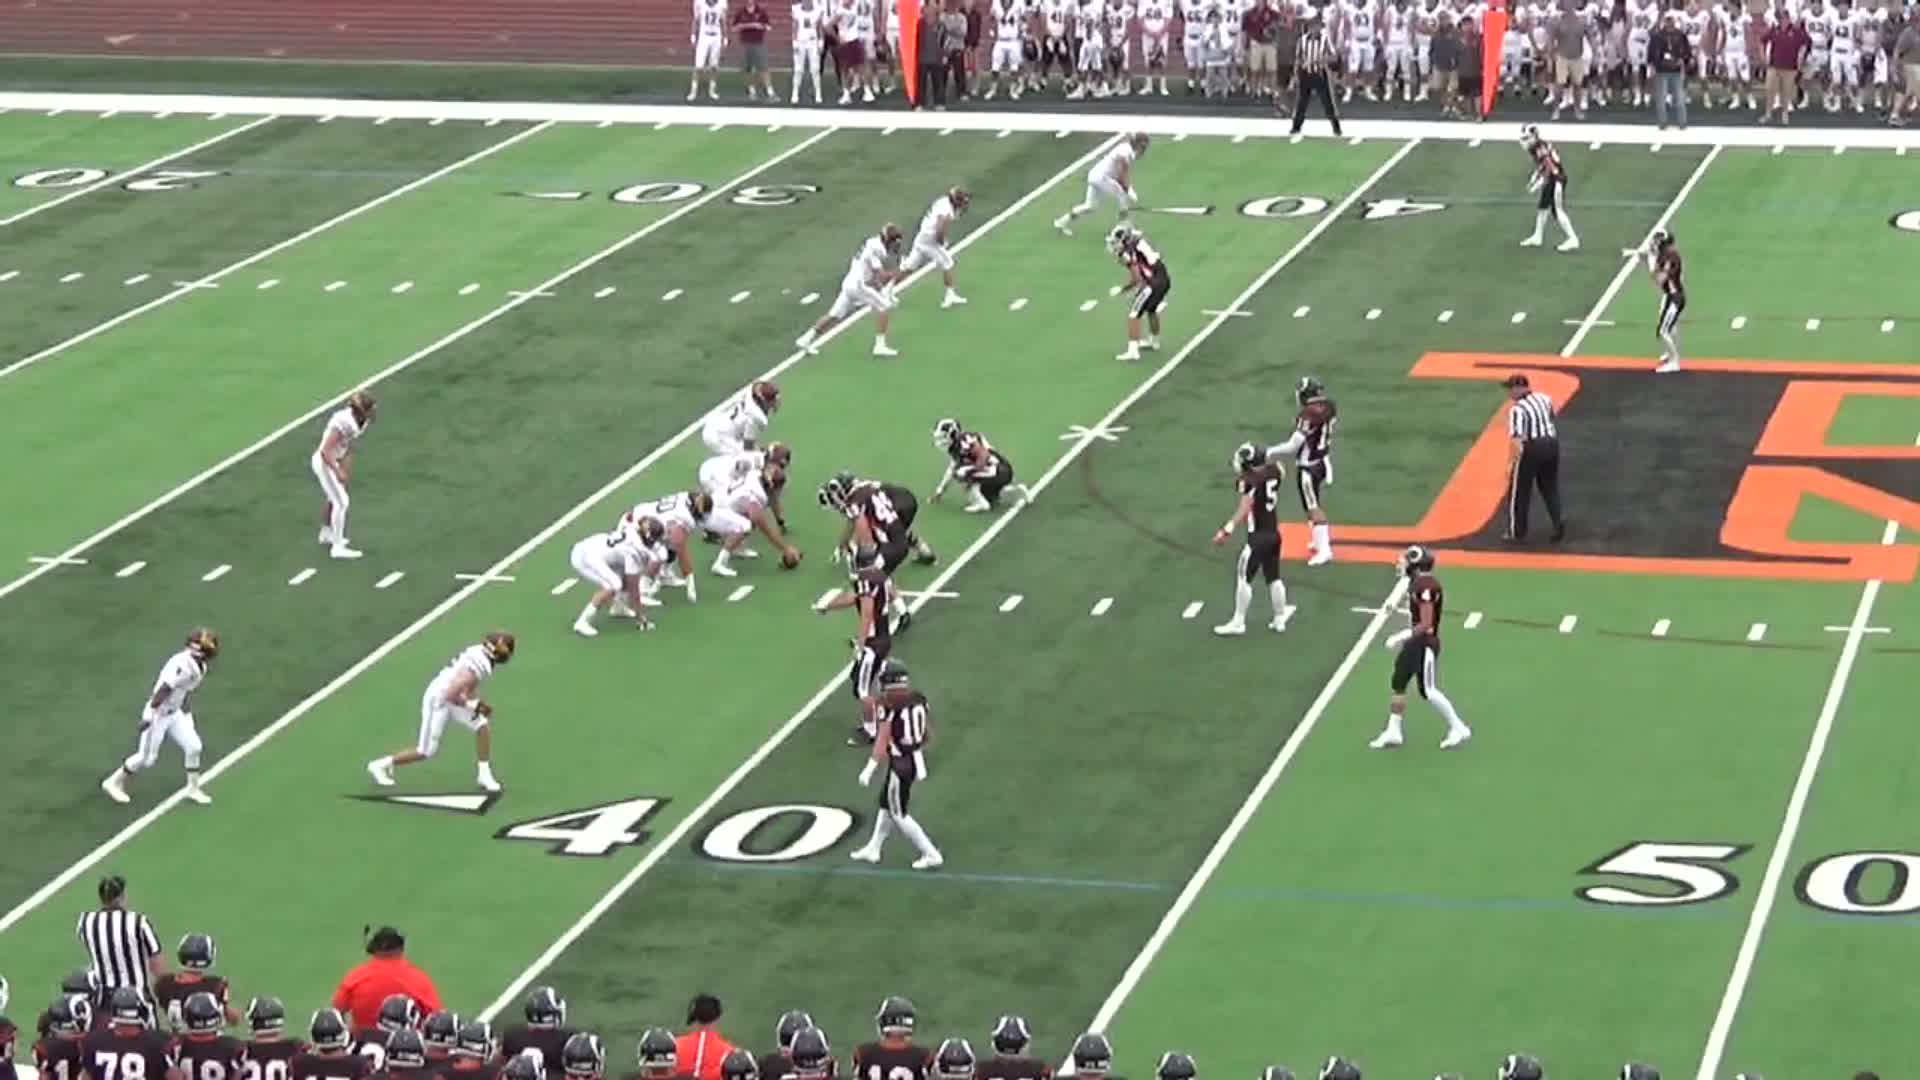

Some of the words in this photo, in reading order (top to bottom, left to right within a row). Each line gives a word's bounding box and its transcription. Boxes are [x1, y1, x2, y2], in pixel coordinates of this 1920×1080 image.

[610, 182, 822, 206] 30
[1240, 196, 1448, 219] 40
[1265, 479, 1279, 512] 5
[1420, 588, 1431, 601] 4
[899, 703, 927, 744] 10
[494, 796, 862, 863] 40
[1573, 839, 1920, 915] 50
[94, 1051, 148, 1080] 78
